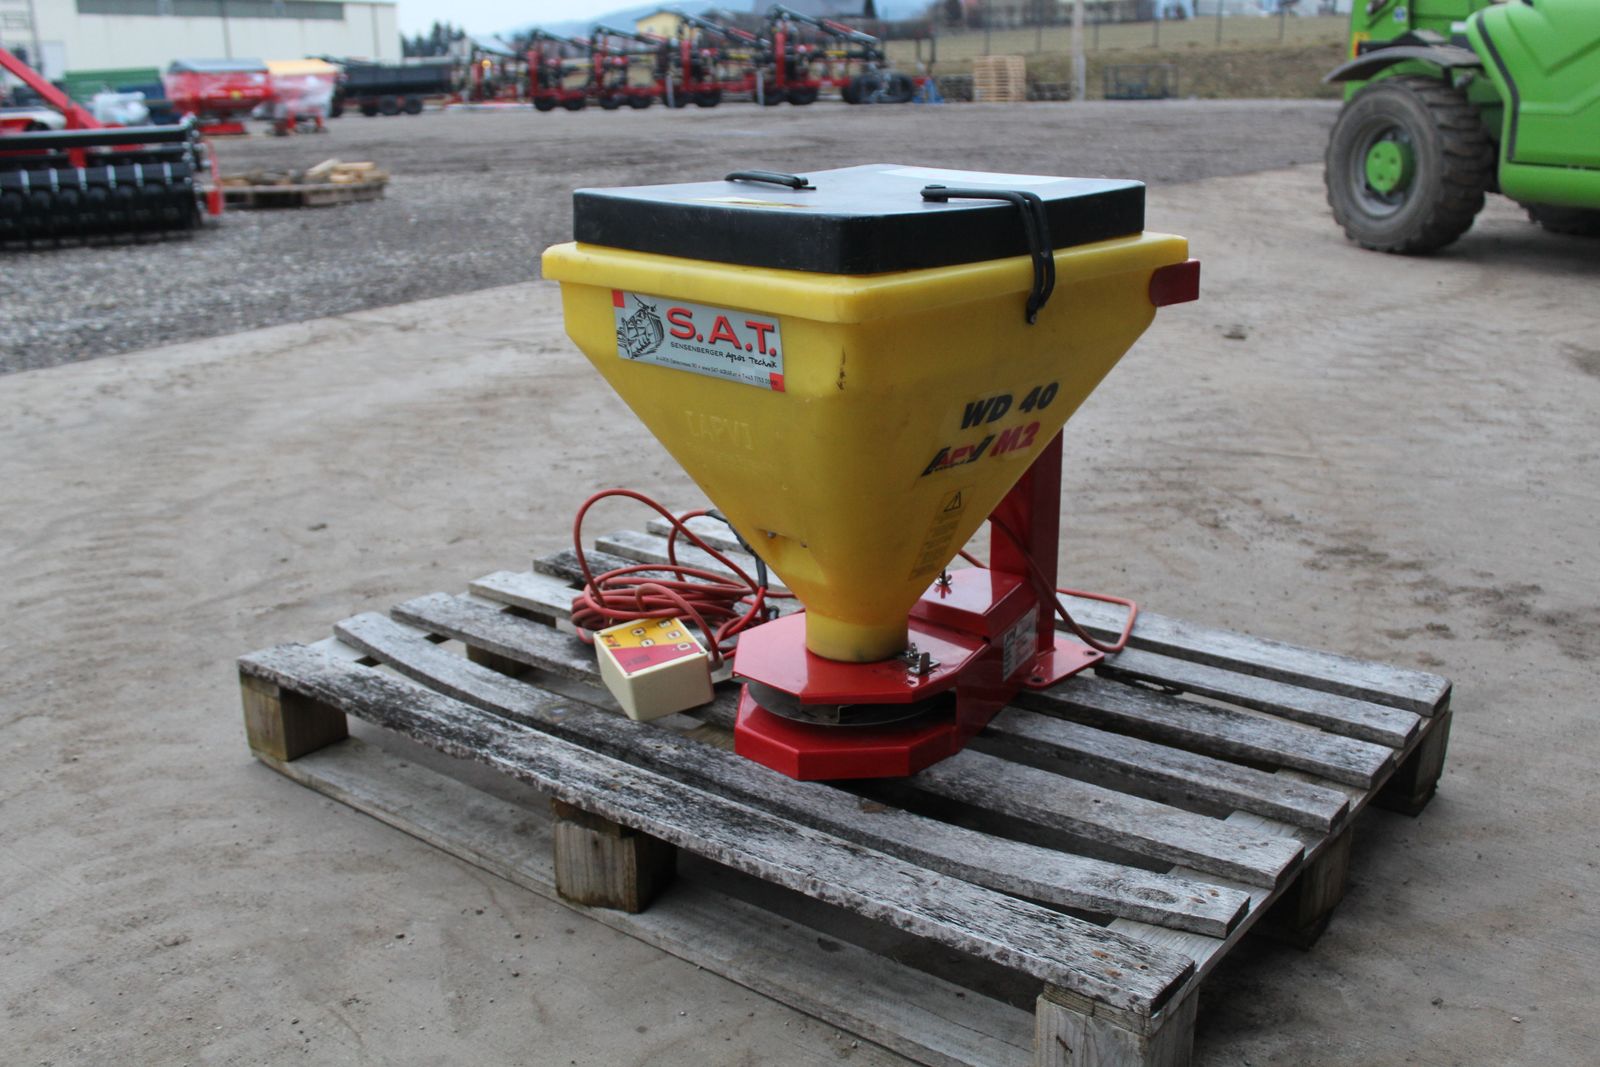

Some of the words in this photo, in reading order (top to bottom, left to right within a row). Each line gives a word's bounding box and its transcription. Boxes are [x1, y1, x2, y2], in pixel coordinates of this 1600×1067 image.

[667, 307, 777, 357] S.A.T.
[670, 342, 724, 357] SENSENBERGER
[748, 356, 778, 369] Technik
[960, 394, 1014, 430] WD
[1018, 382, 1059, 414] 40
[989, 421, 1041, 457] M2
